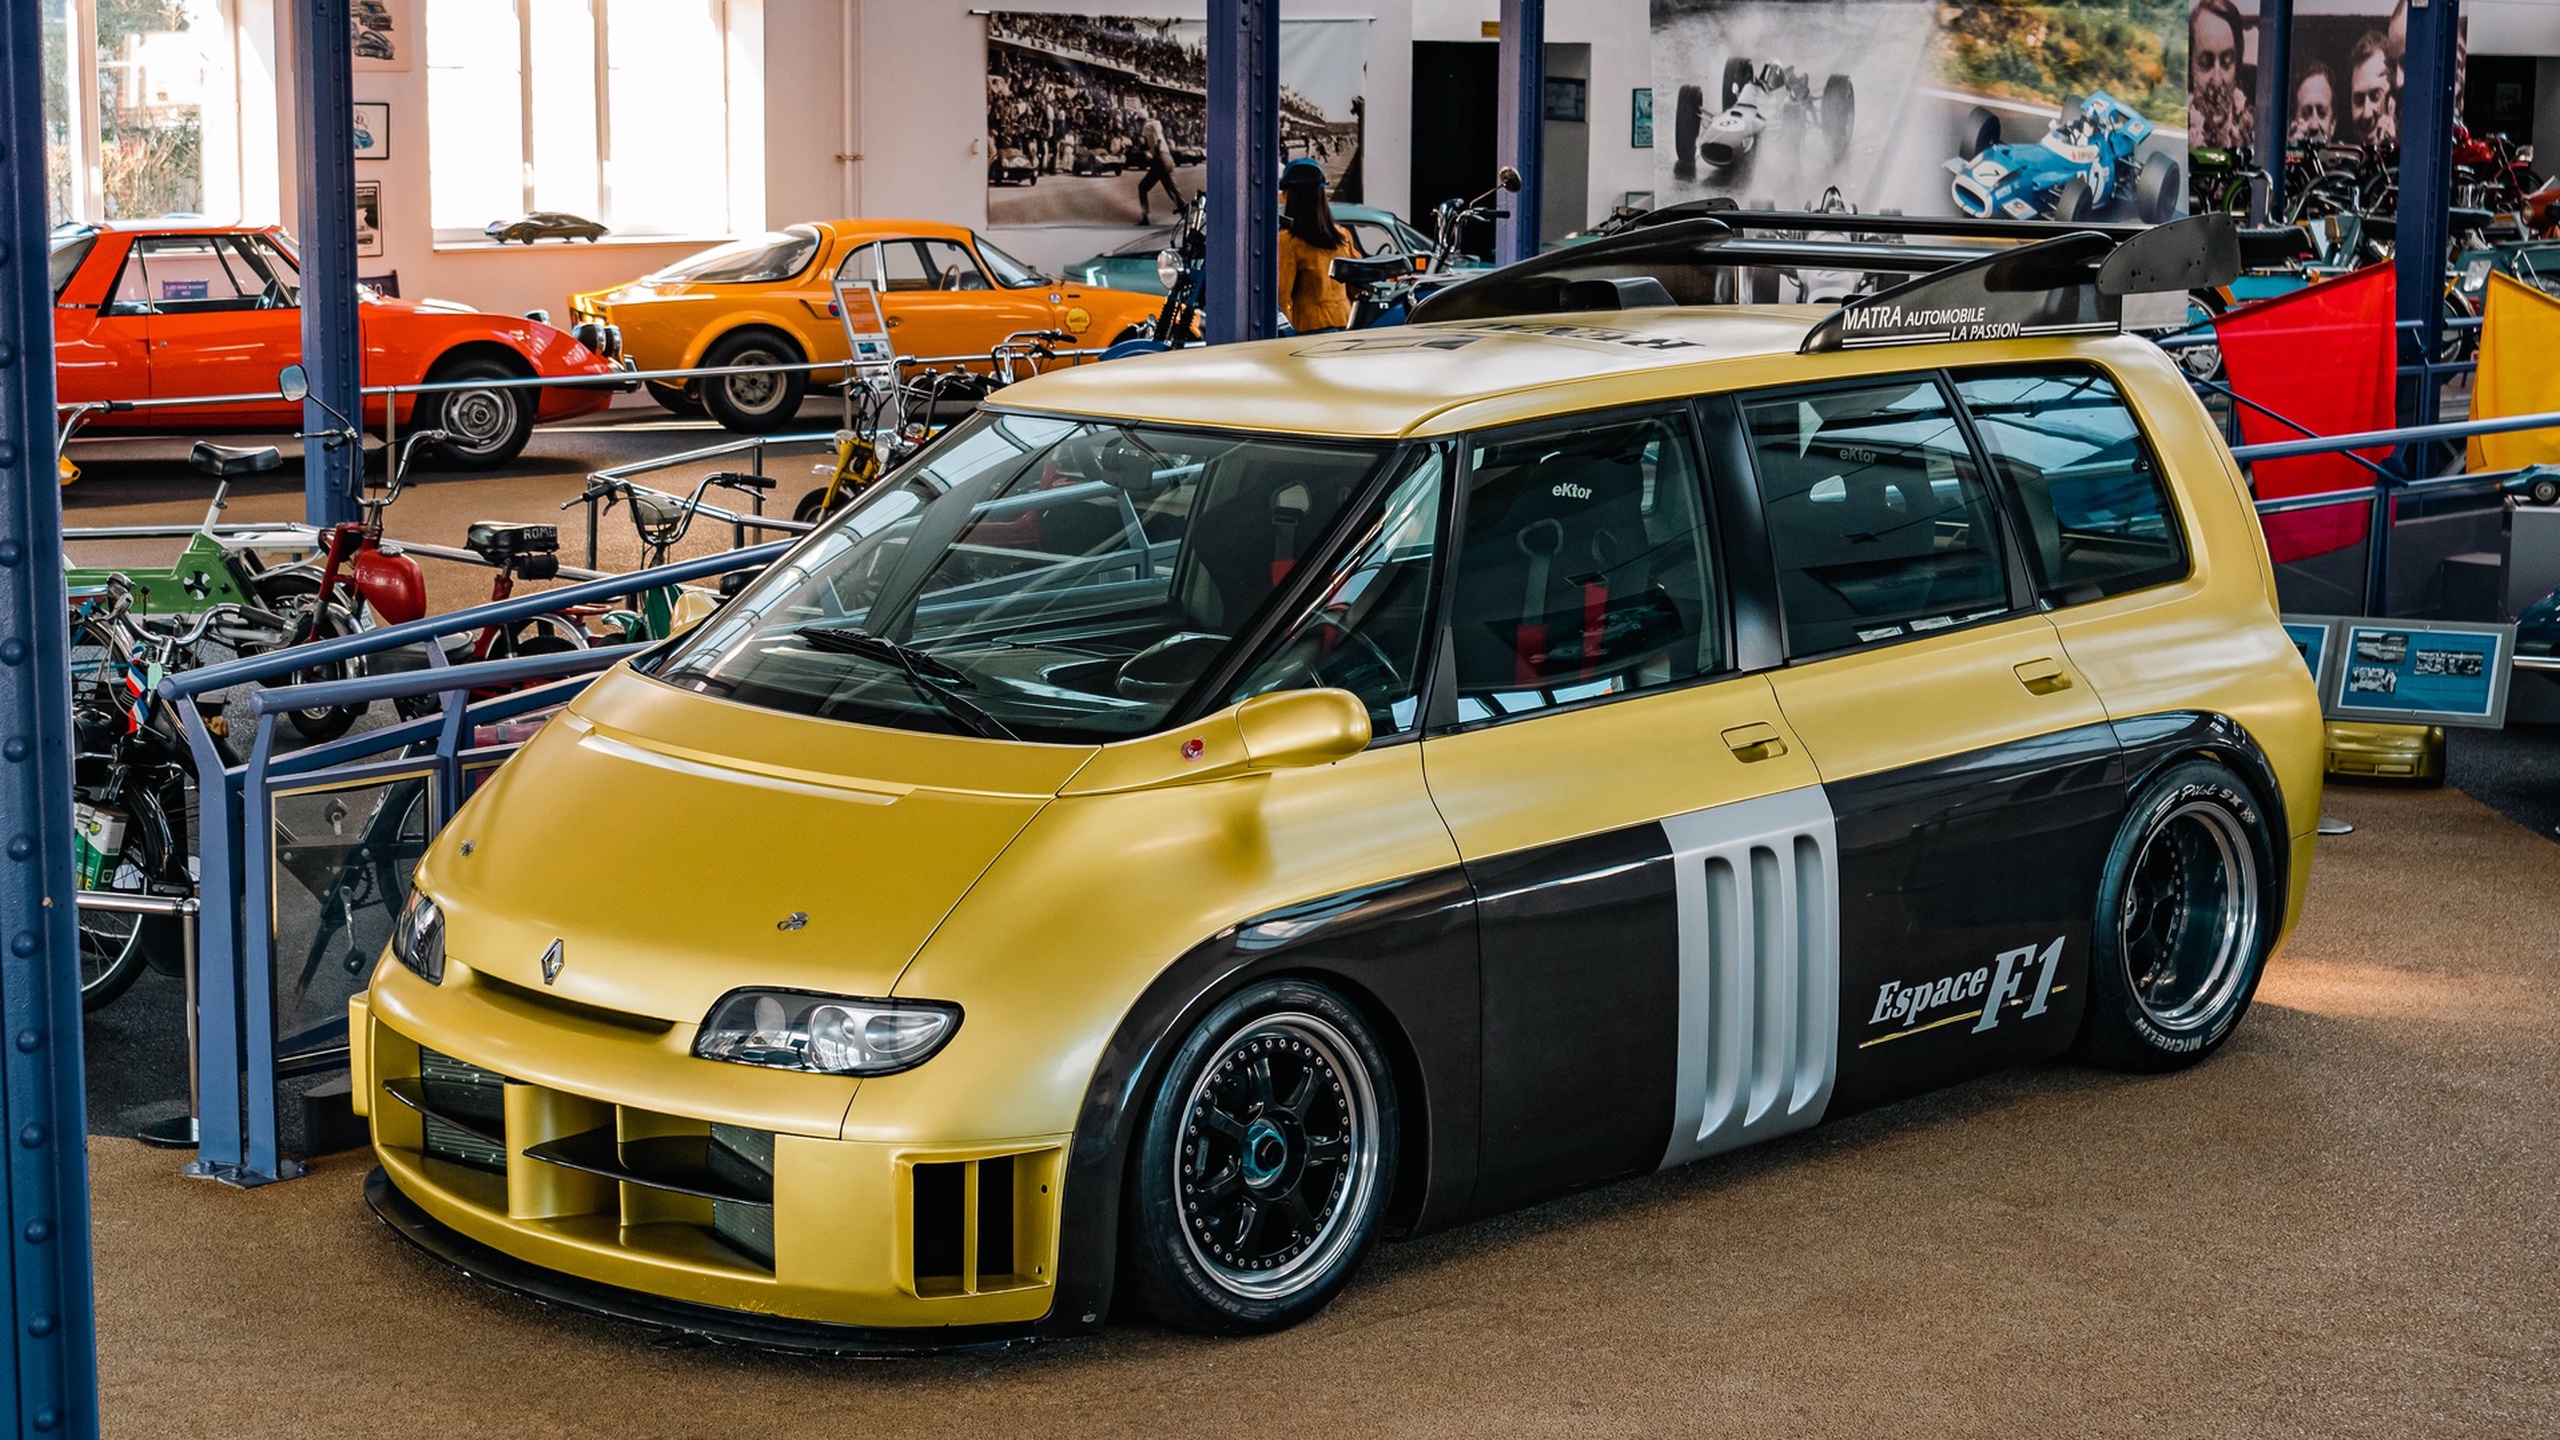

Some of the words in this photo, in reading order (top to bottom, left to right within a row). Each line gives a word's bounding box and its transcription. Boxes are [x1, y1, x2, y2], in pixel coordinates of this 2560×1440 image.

[1842, 306, 1901, 330] MATRA
[1904, 307, 1986, 327] AUTOMOBILE
[1950, 326, 1967, 341] LA
[1969, 322, 2020, 340] PASSION
[1840, 446, 1877, 464] eKtor
[1552, 482, 1592, 500] eKtor
[2180, 784, 2218, 801] Pilot
[2219, 788, 2244, 807] SX
[89, 822, 101, 832] BP
[1868, 967, 1988, 1027] Espace
[1971, 935, 2066, 1034] F1
[2135, 1017, 2203, 1052] MICHELIN
[1171, 1242, 1242, 1313] MICHELIN
